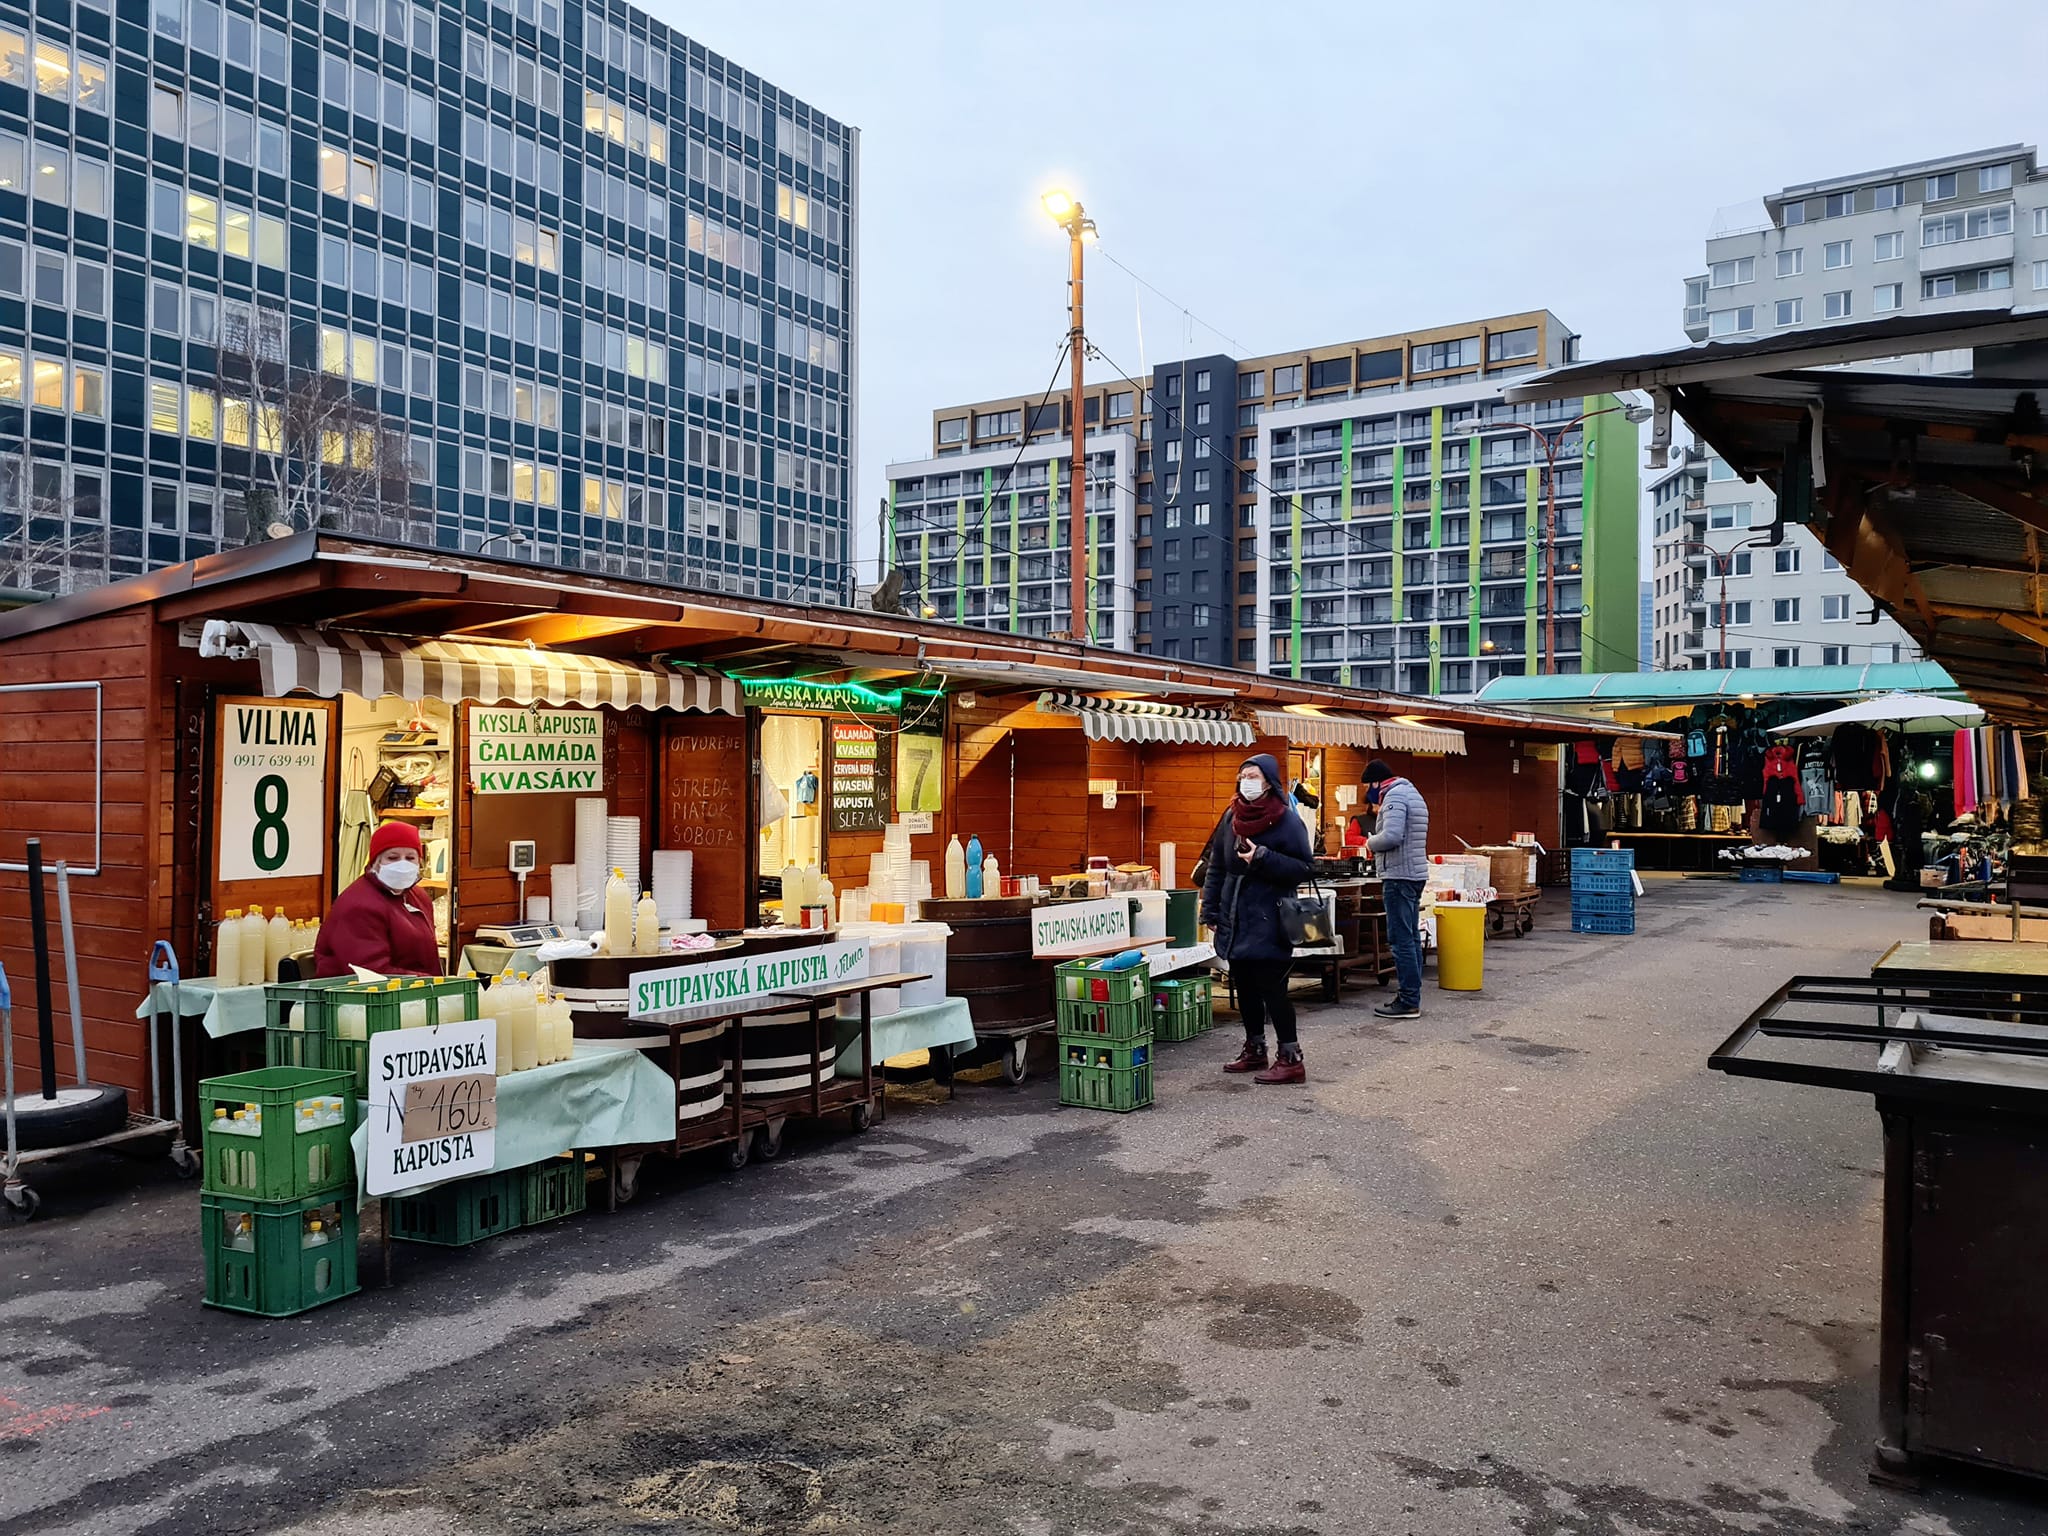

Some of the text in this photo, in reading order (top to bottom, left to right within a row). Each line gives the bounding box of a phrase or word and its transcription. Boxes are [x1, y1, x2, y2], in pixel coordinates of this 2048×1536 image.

[816, 688, 876, 706] KAPUSTA
[237, 708, 317, 746] VILMA
[478, 711, 527, 733] KYSLÁ
[833, 728, 875, 740] ČALAMÁDA
[233, 754, 316, 767] 0917 639 491
[478, 739, 597, 762] ČALAMÁDA
[836, 743, 877, 758] KVASÁKY
[480, 768, 597, 791] KVASÁKY
[672, 778, 733, 797] STREDA
[906, 748, 933, 811] 7
[833, 796, 874, 809] KAPUSTA
[252, 774, 290, 872] 8
[673, 824, 734, 846] SOBOTA
[1038, 910, 1126, 947] STUPAVSKÁ KAPUSTA
[638, 947, 864, 1013] STUPAVSKÁ KAPUSTA Vilma
[382, 1034, 487, 1082] STUPAVSKÁ
[393, 1134, 475, 1175] KAPUSTA
